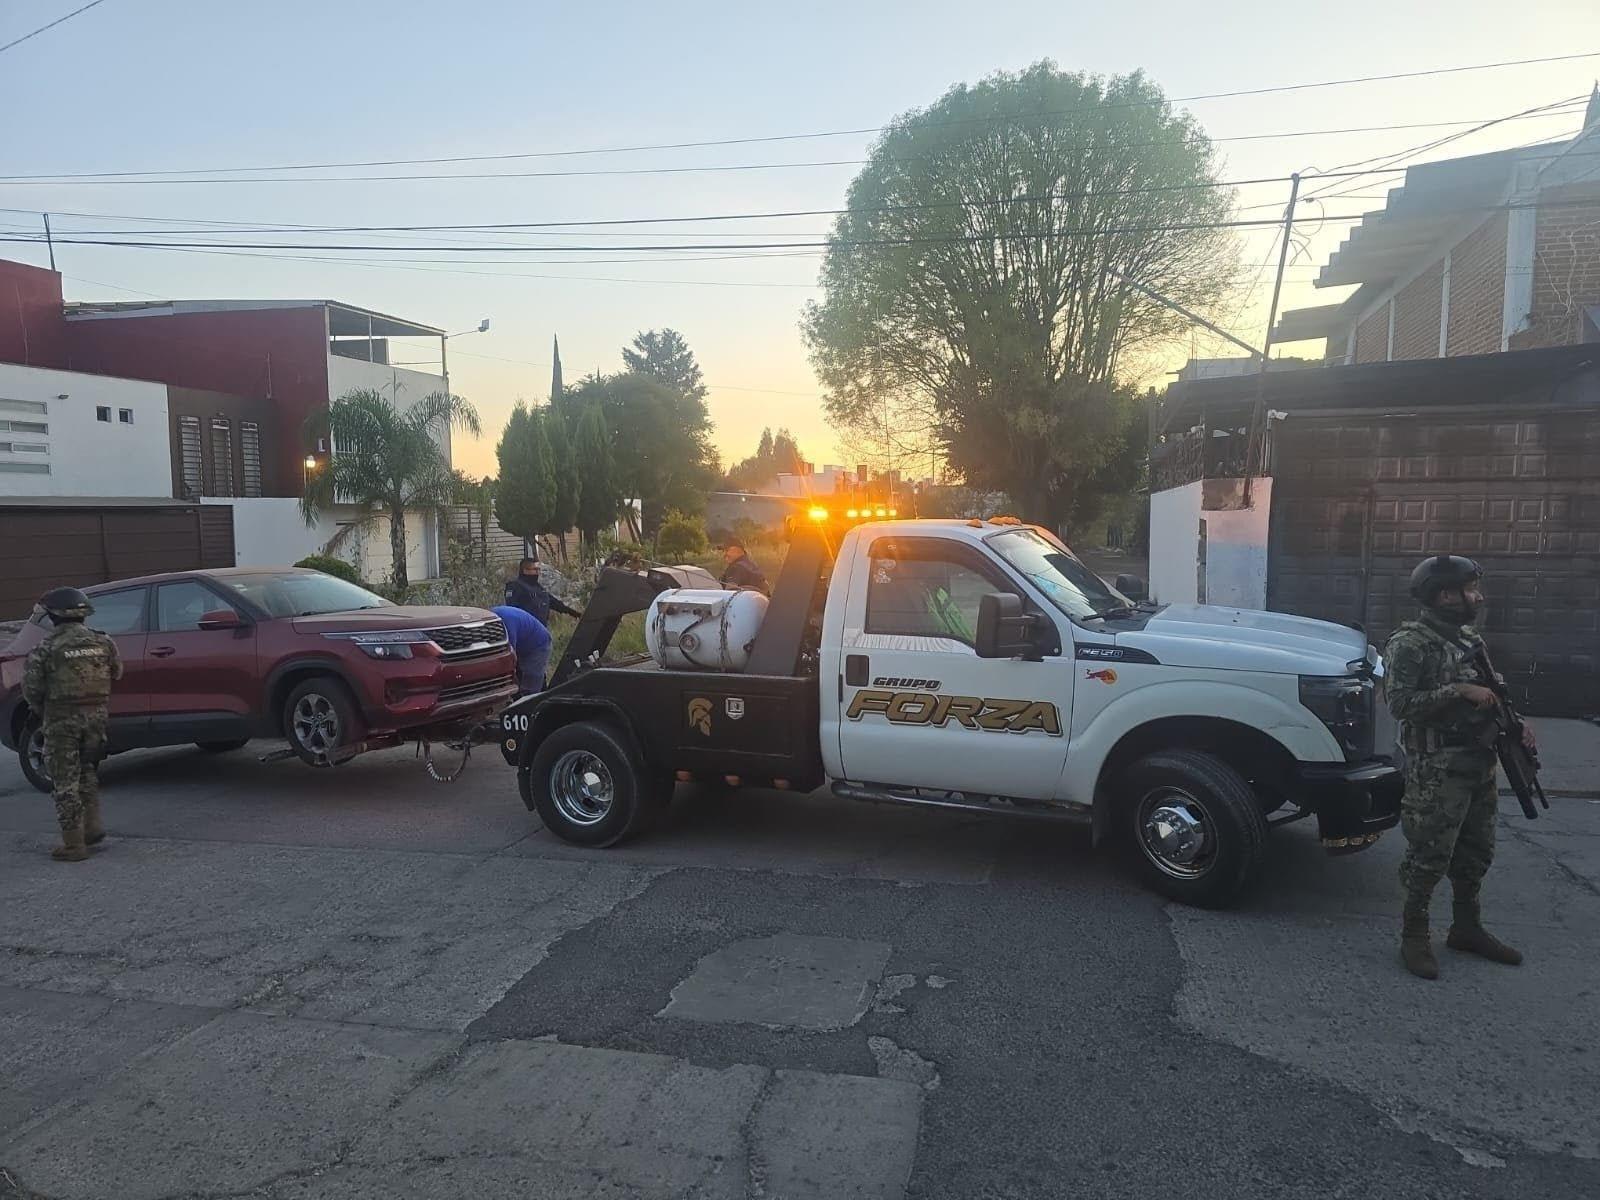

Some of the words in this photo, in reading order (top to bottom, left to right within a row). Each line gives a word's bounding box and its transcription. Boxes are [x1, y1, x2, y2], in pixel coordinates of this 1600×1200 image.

[872, 676, 941, 690] GRUPO
[846, 689, 1062, 737] FORZA
[503, 714, 529, 731] 610
